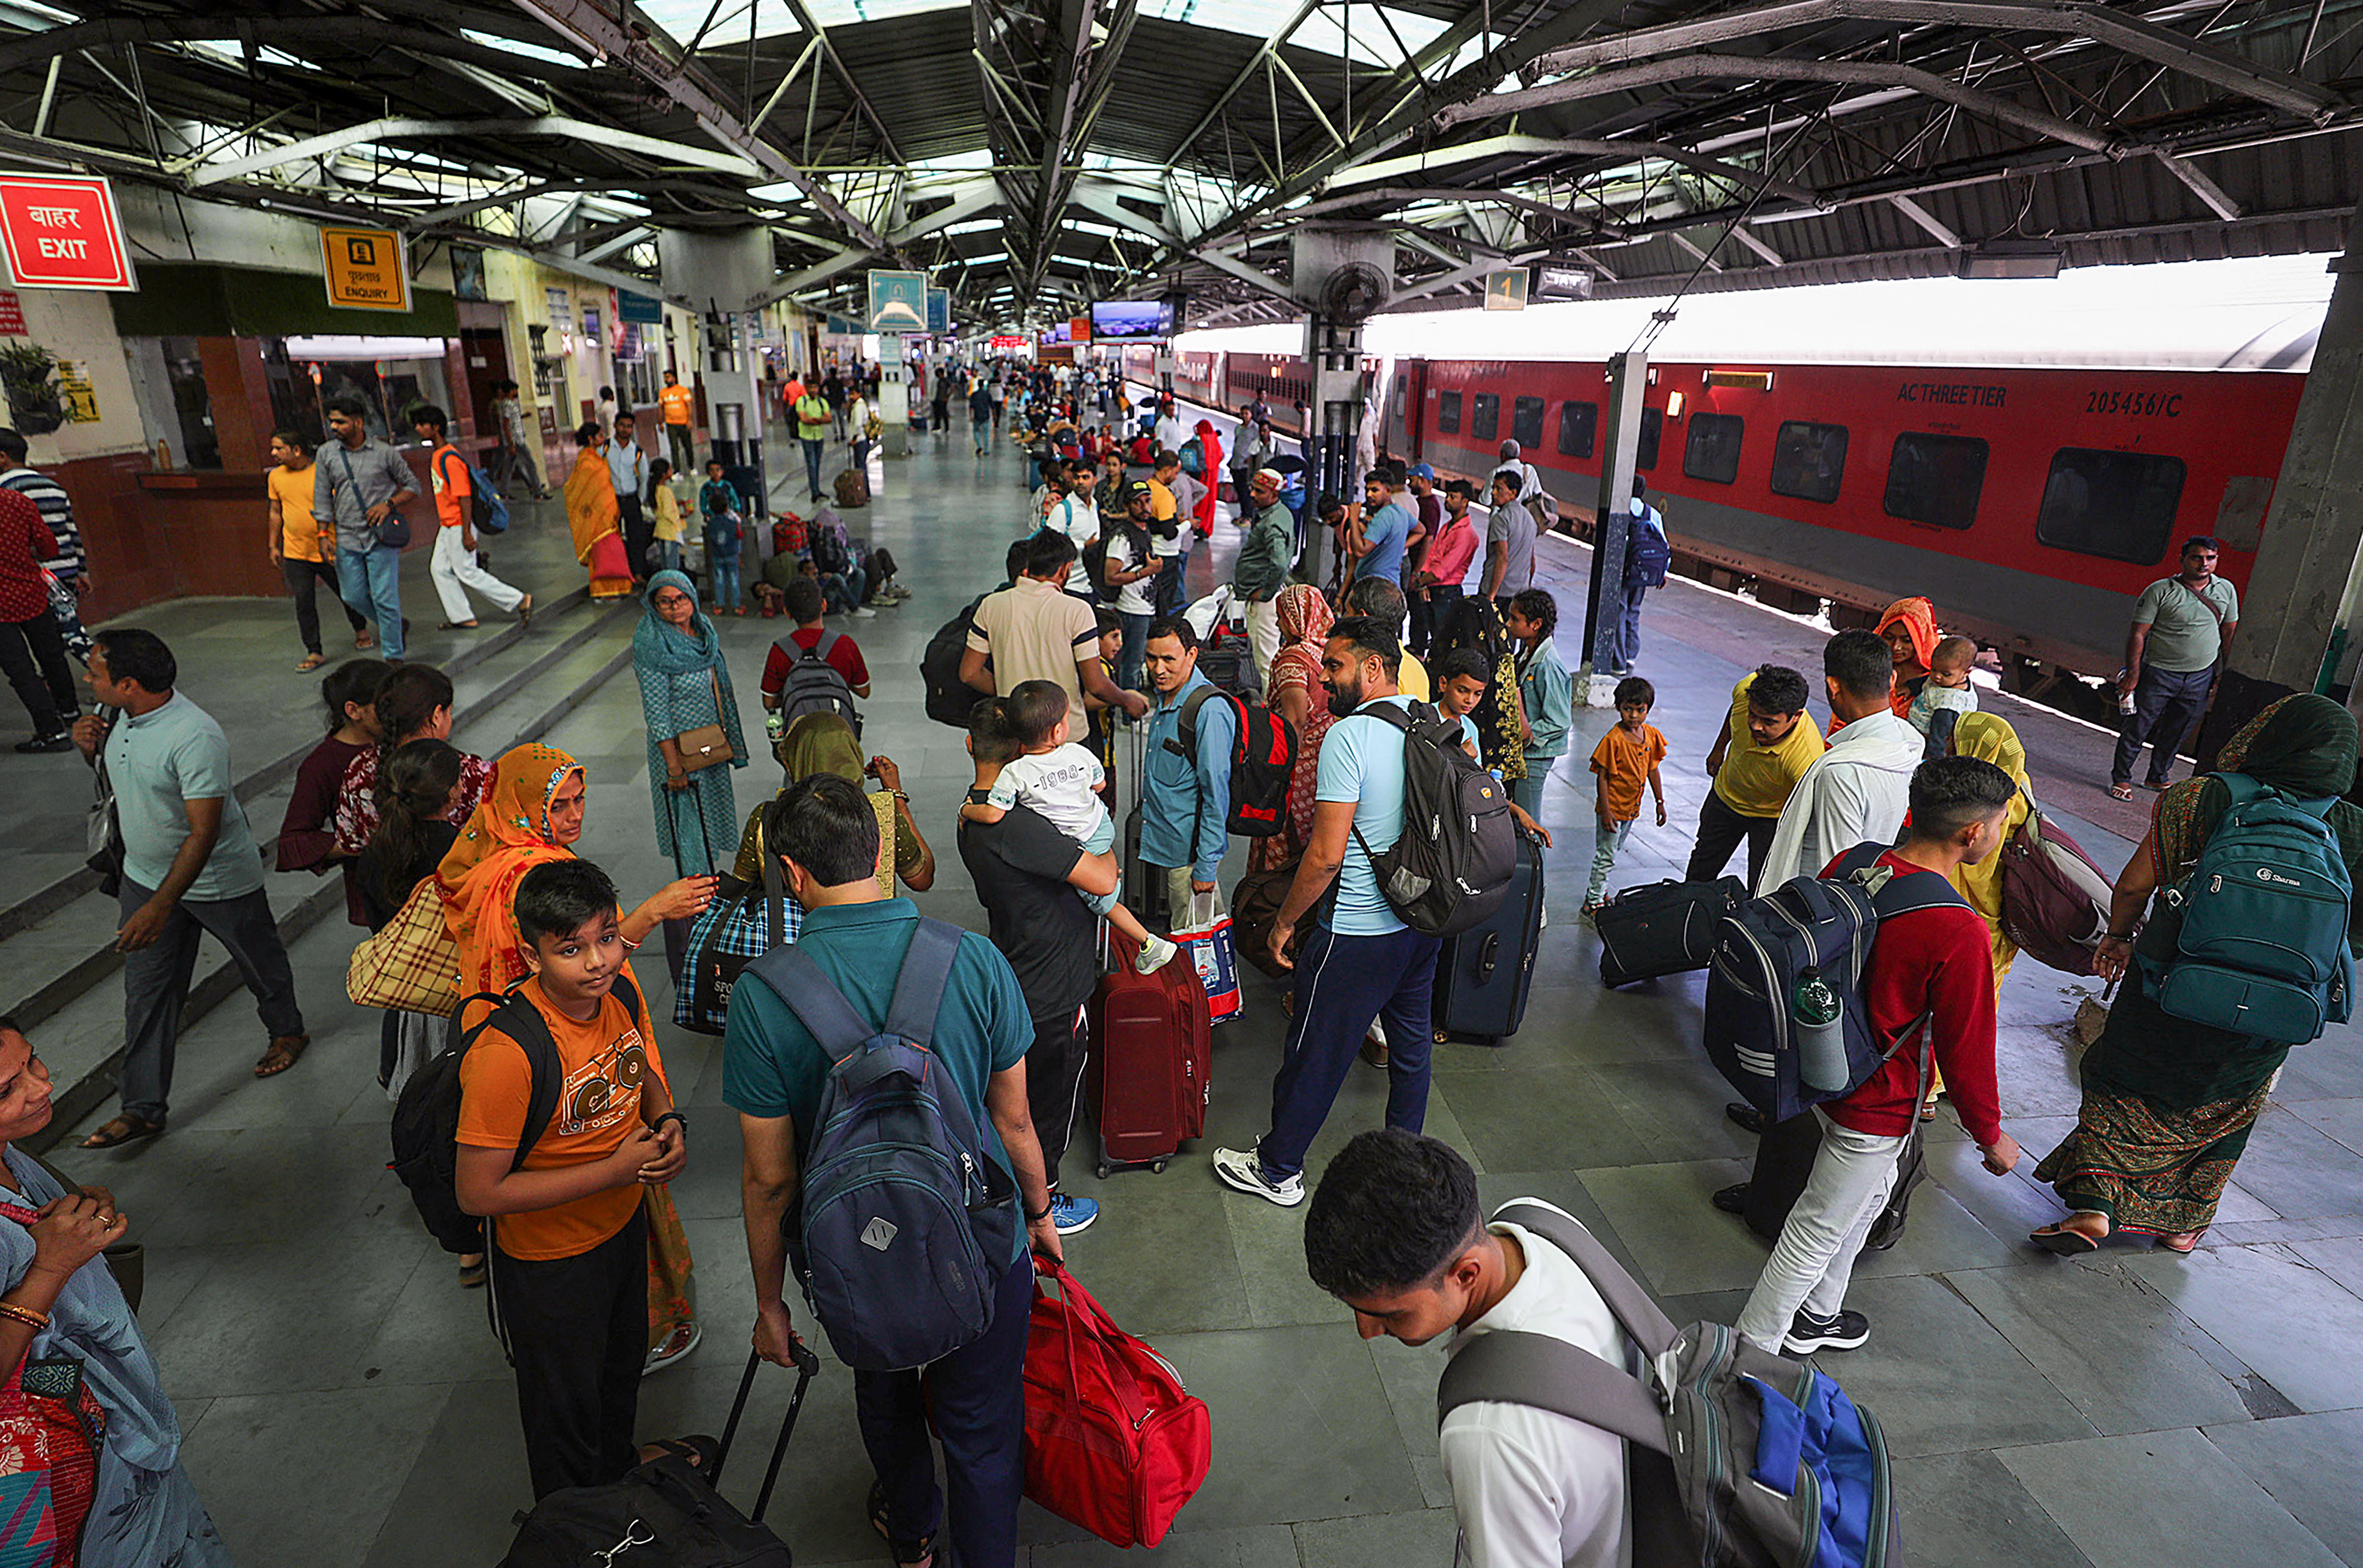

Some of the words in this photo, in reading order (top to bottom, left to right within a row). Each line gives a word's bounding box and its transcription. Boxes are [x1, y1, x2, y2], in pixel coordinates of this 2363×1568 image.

[27, 205, 81, 229] बाहर
[38, 237, 87, 259] EXIT
[345, 287, 387, 298] ENQUIRY
[1501, 277, 1511, 306] 1
[1897, 383, 1918, 402] AC
[1921, 384, 1969, 405] THREE
[1972, 385, 2007, 407] TIER
[2085, 391, 2182, 417] 205456/C
